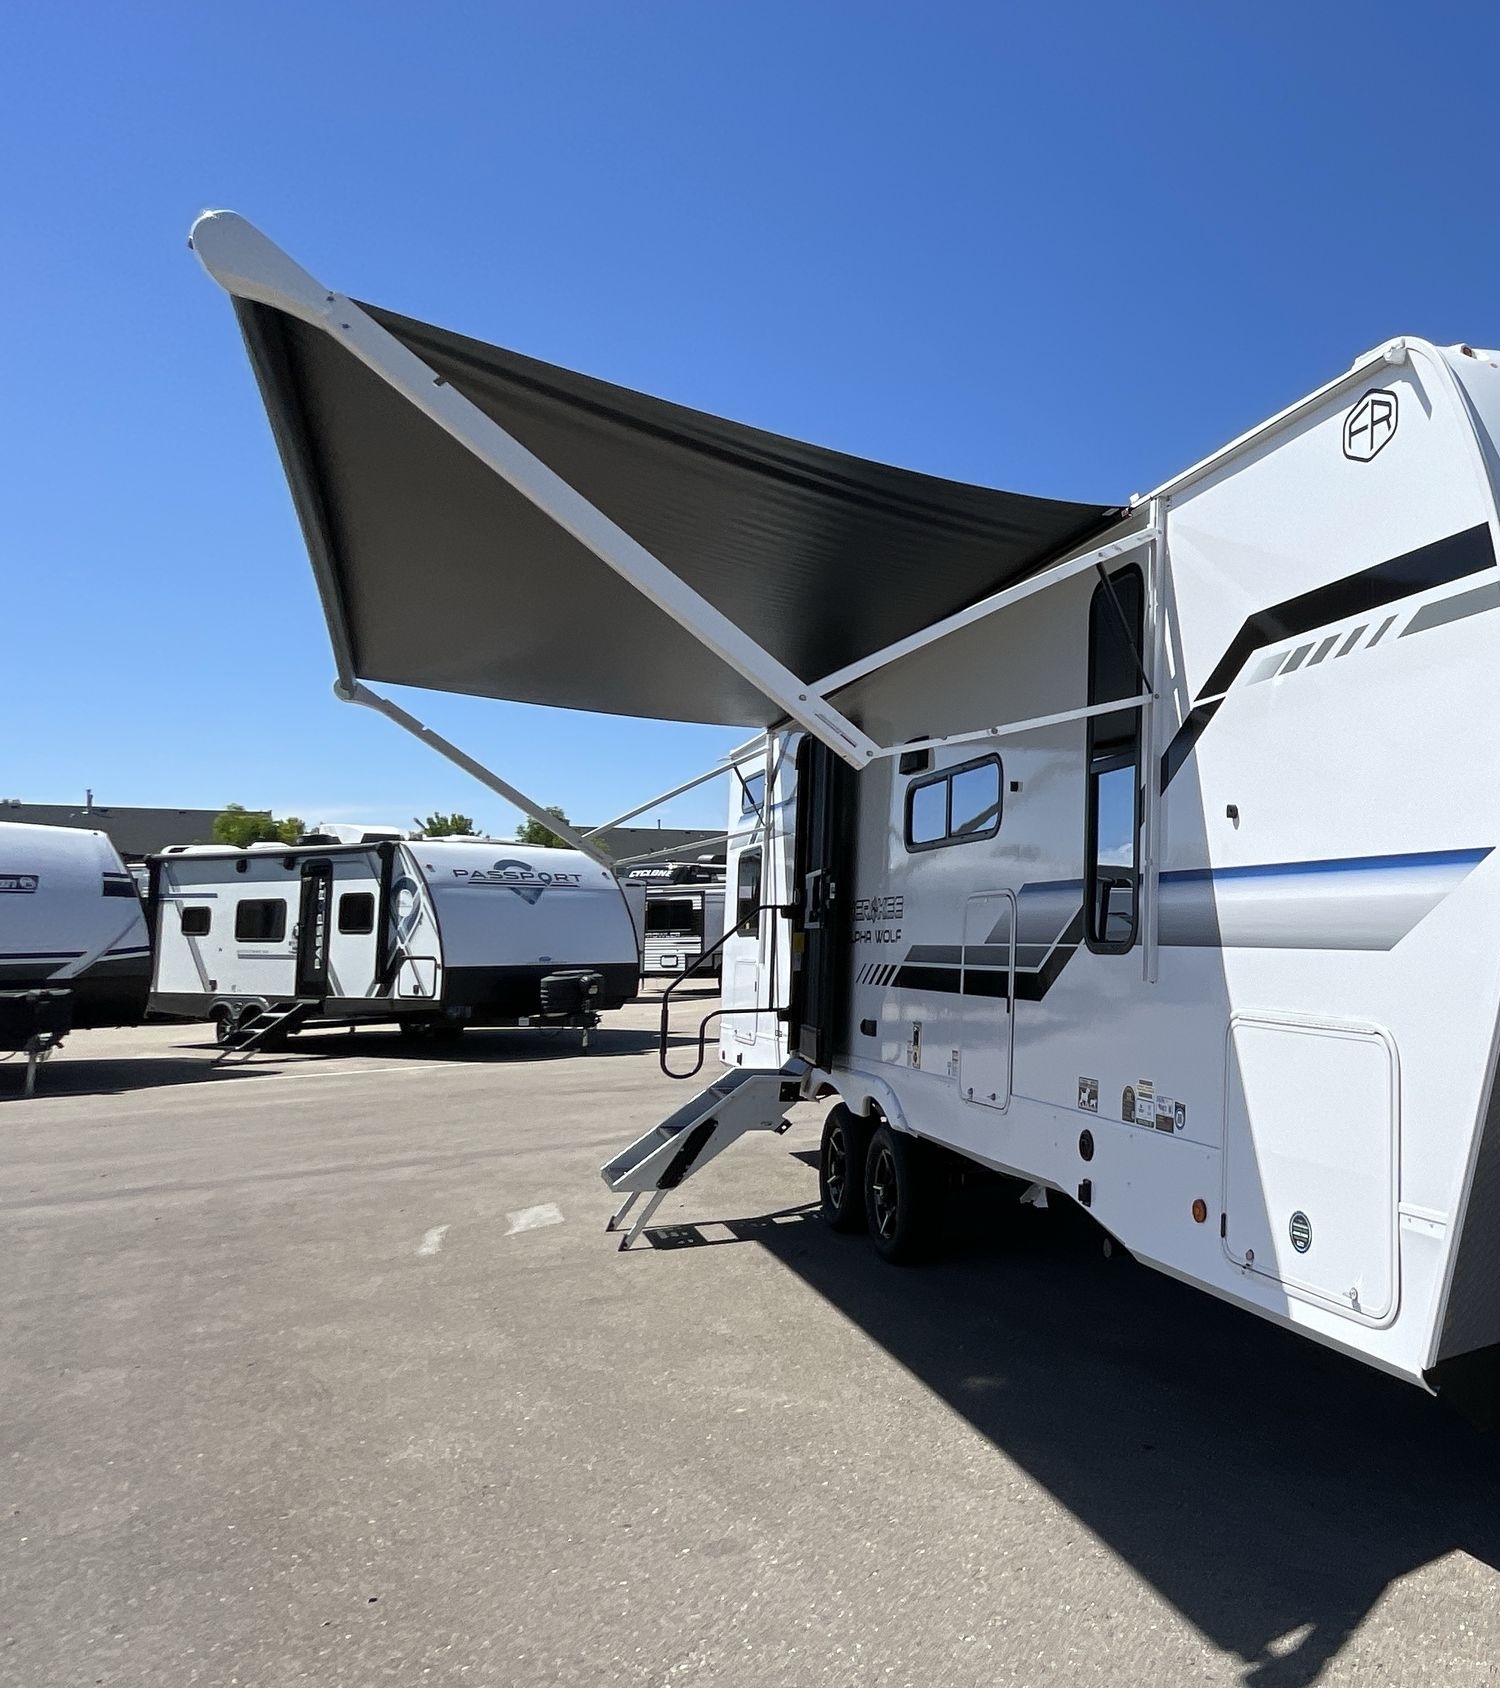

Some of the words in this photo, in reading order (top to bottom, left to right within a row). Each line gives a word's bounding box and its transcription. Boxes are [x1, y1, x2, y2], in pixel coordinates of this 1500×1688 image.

[452, 868, 582, 886] PASSPORT
[628, 869, 674, 878] CYCLONE
[875, 929, 902, 944] WOLF
